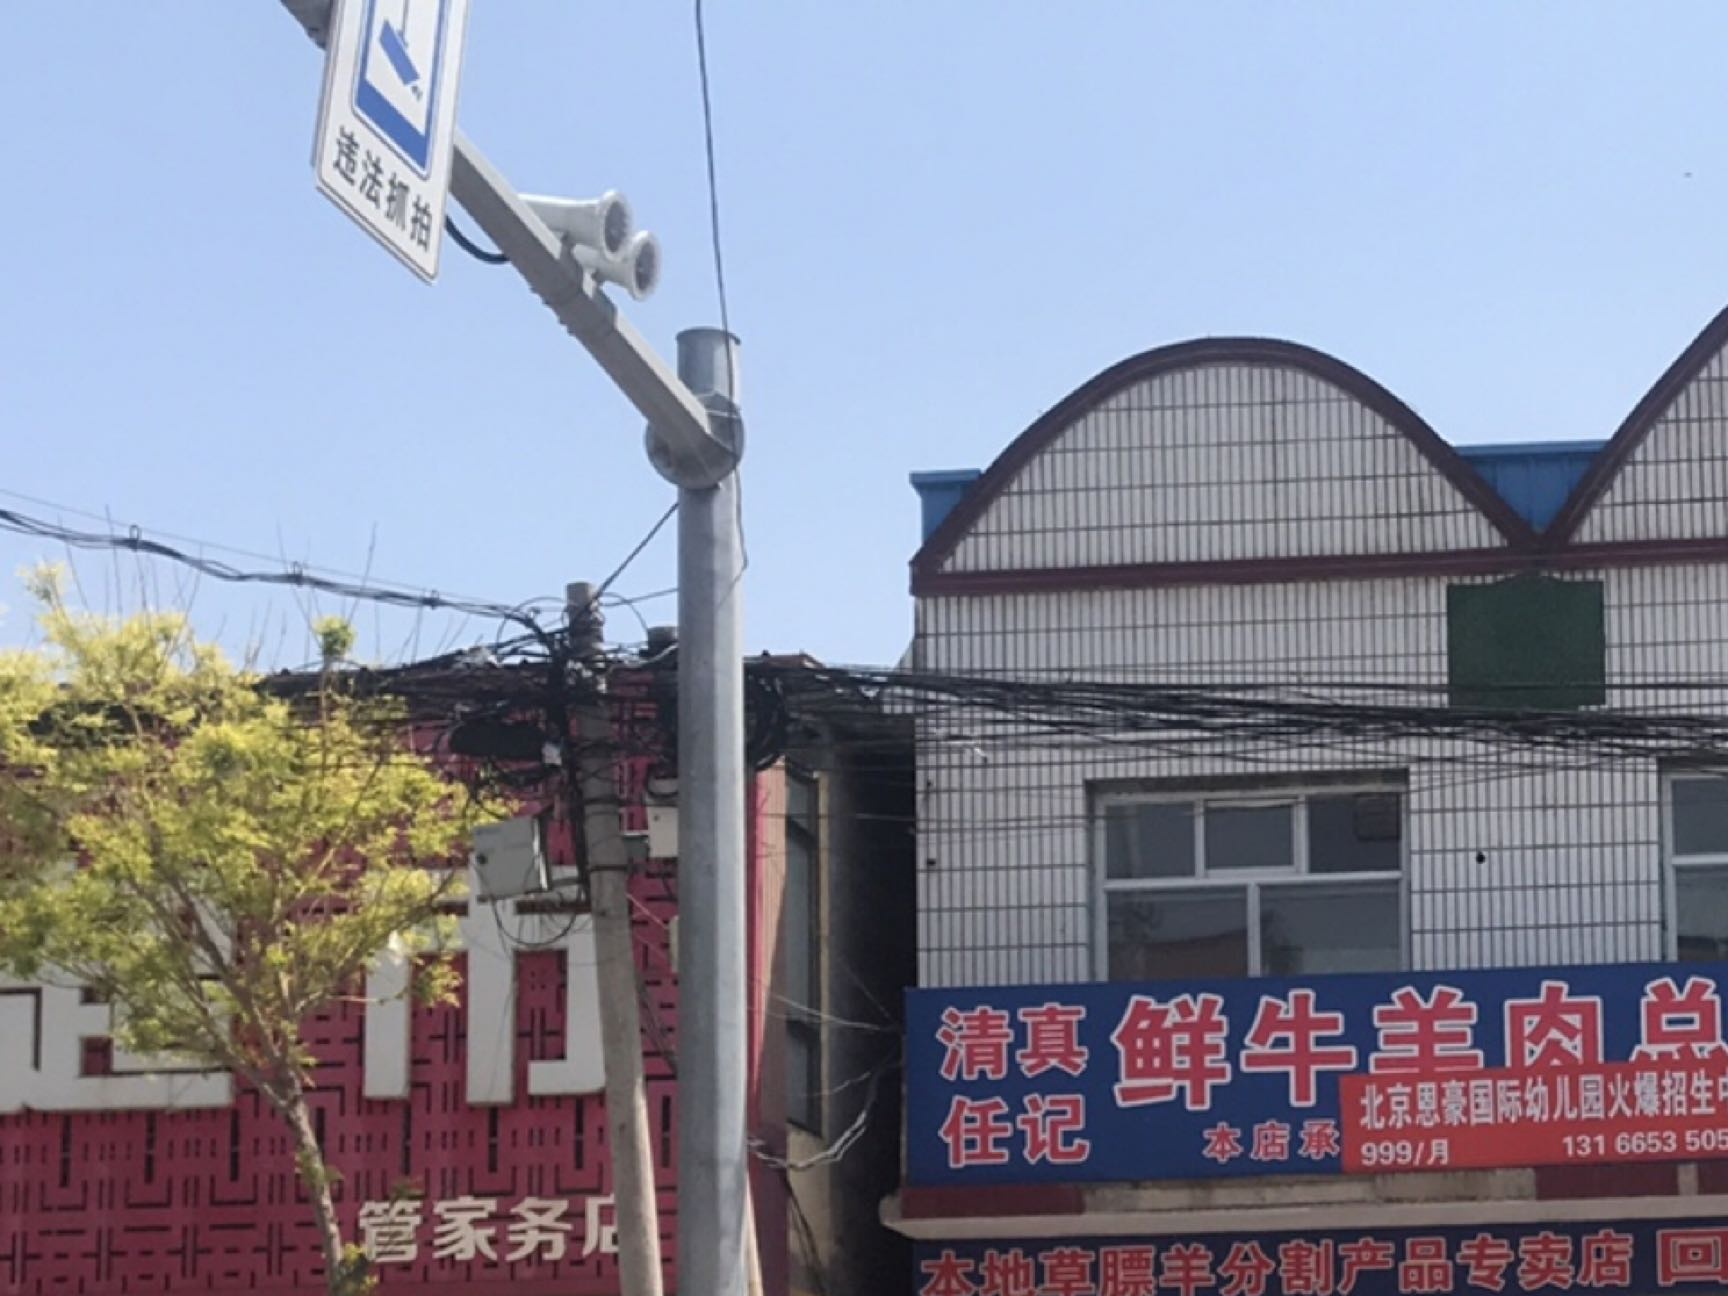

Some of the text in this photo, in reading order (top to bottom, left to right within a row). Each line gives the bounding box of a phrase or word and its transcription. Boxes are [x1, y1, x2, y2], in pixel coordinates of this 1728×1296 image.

[333, 125, 433, 252] 违法抓拍
[935, 1003, 1090, 1081] 清真
[938, 1094, 1091, 1168] 任记
[1361, 1139, 1450, 1166] 999/月
[1563, 1135, 1605, 1158] 131
[1614, 1131, 1678, 1155] 6653
